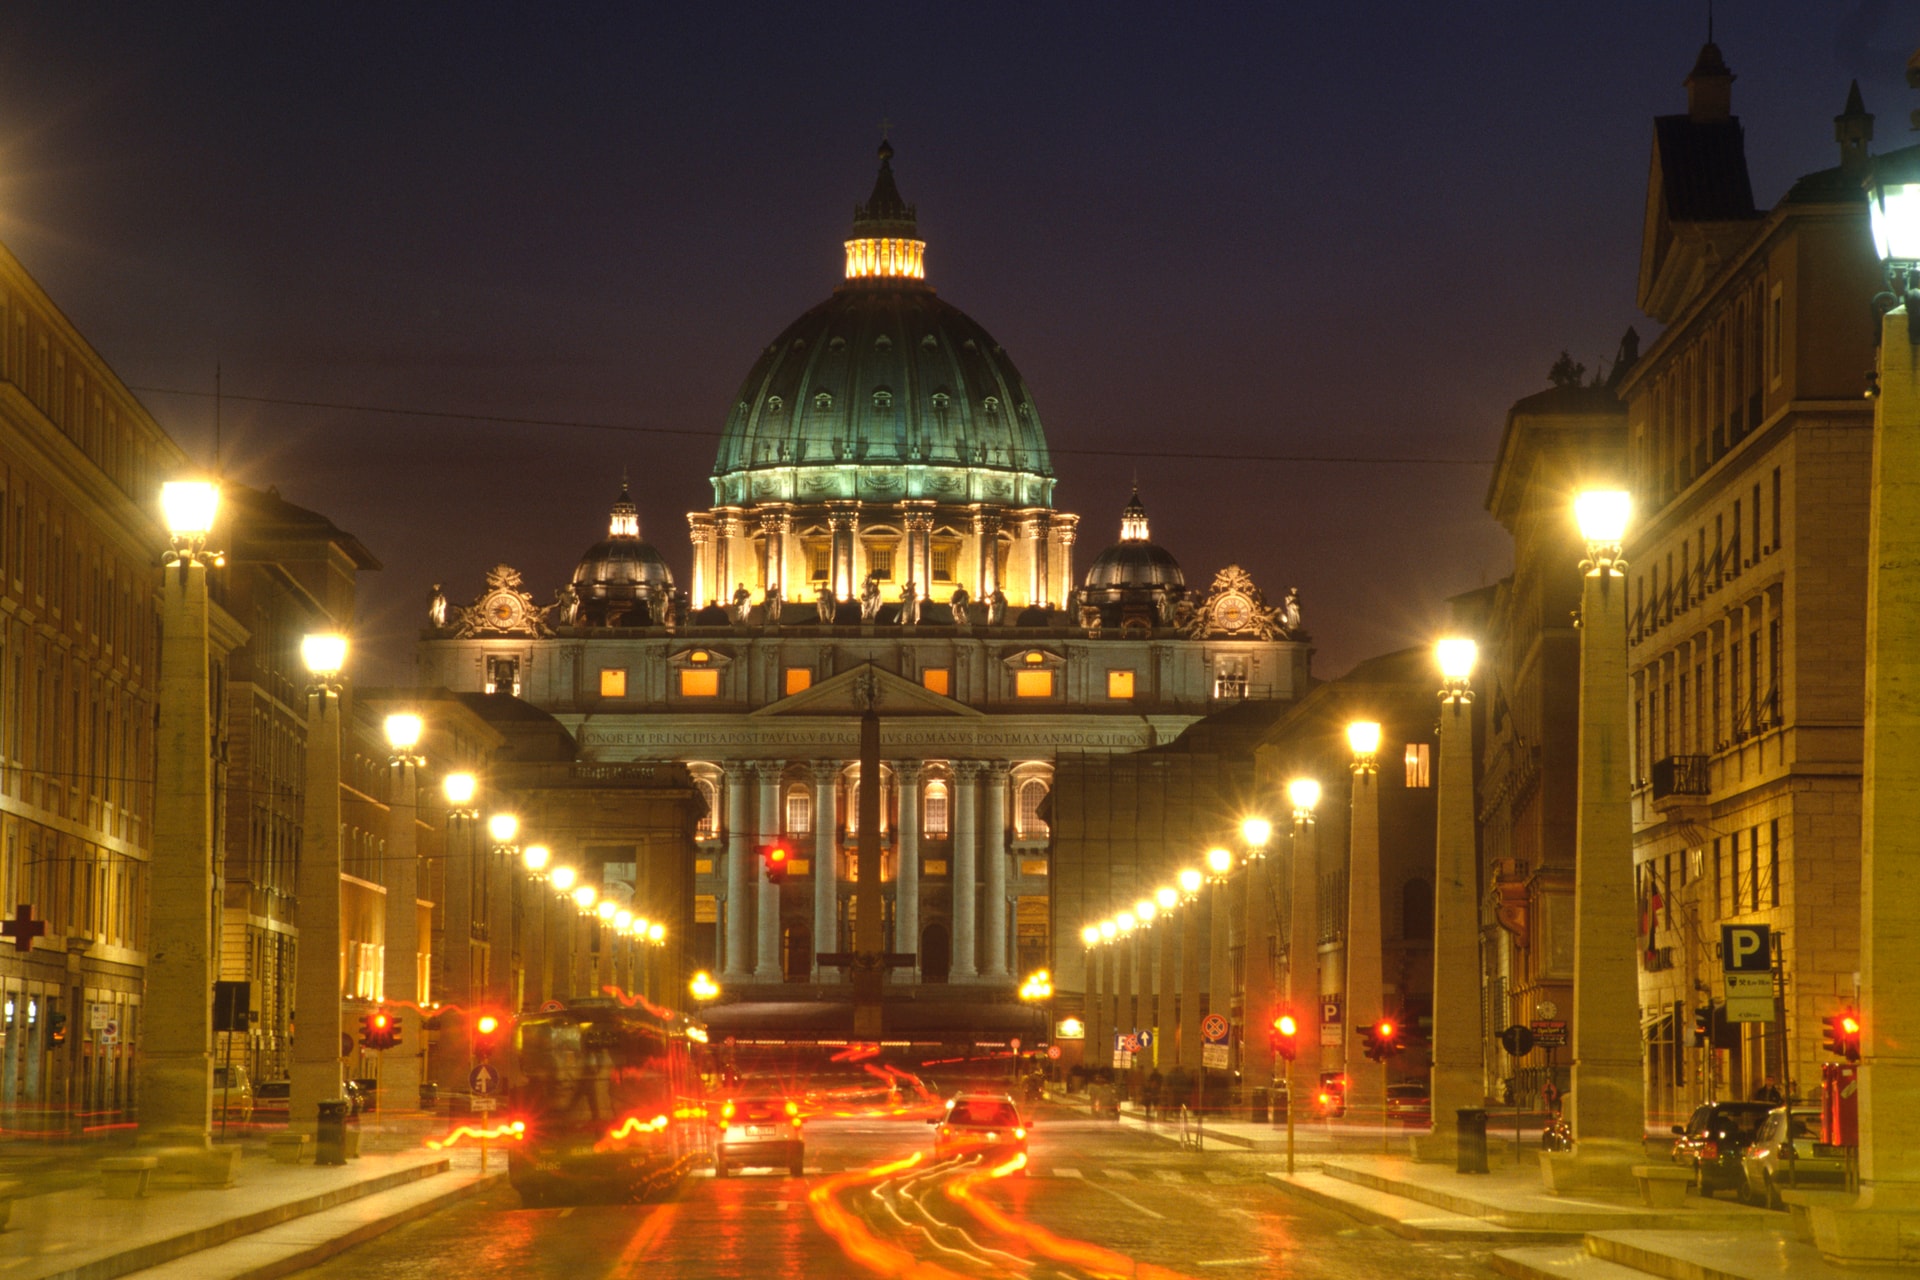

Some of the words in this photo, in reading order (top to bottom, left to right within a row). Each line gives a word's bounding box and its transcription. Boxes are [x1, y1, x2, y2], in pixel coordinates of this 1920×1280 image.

[905, 733, 973, 743] ROMANVS
[1732, 930, 1760, 968] P
[1324, 1004, 1337, 1021] P
